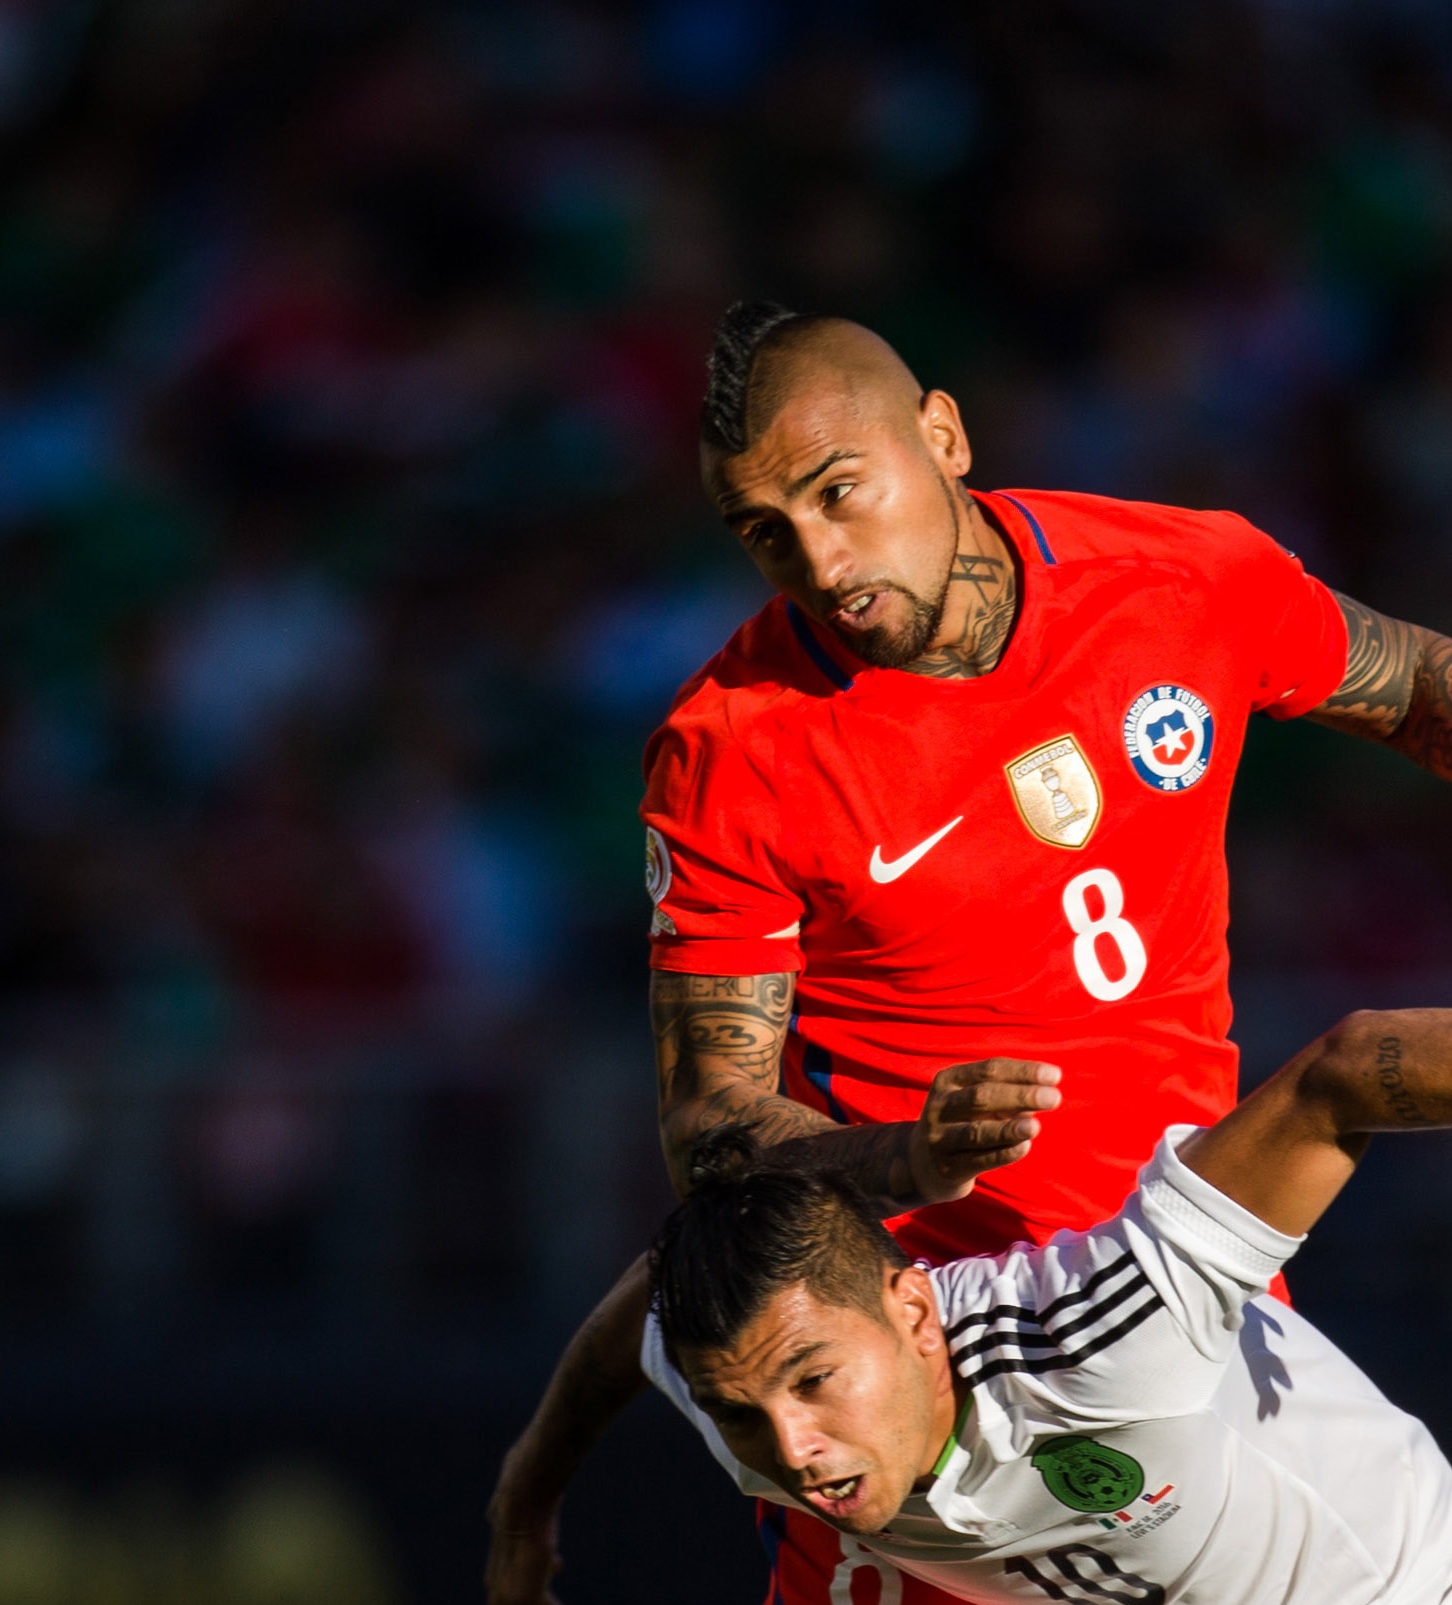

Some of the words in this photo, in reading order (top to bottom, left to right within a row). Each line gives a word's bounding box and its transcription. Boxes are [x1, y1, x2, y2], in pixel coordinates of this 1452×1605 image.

[1124, 691, 1154, 759] FEDERACION
[1157, 686, 1173, 700] DE
[1175, 688, 1210, 722] FUTBOL
[1013, 743, 1075, 779] CONMEBOL
[1063, 868, 1147, 1001] 8
